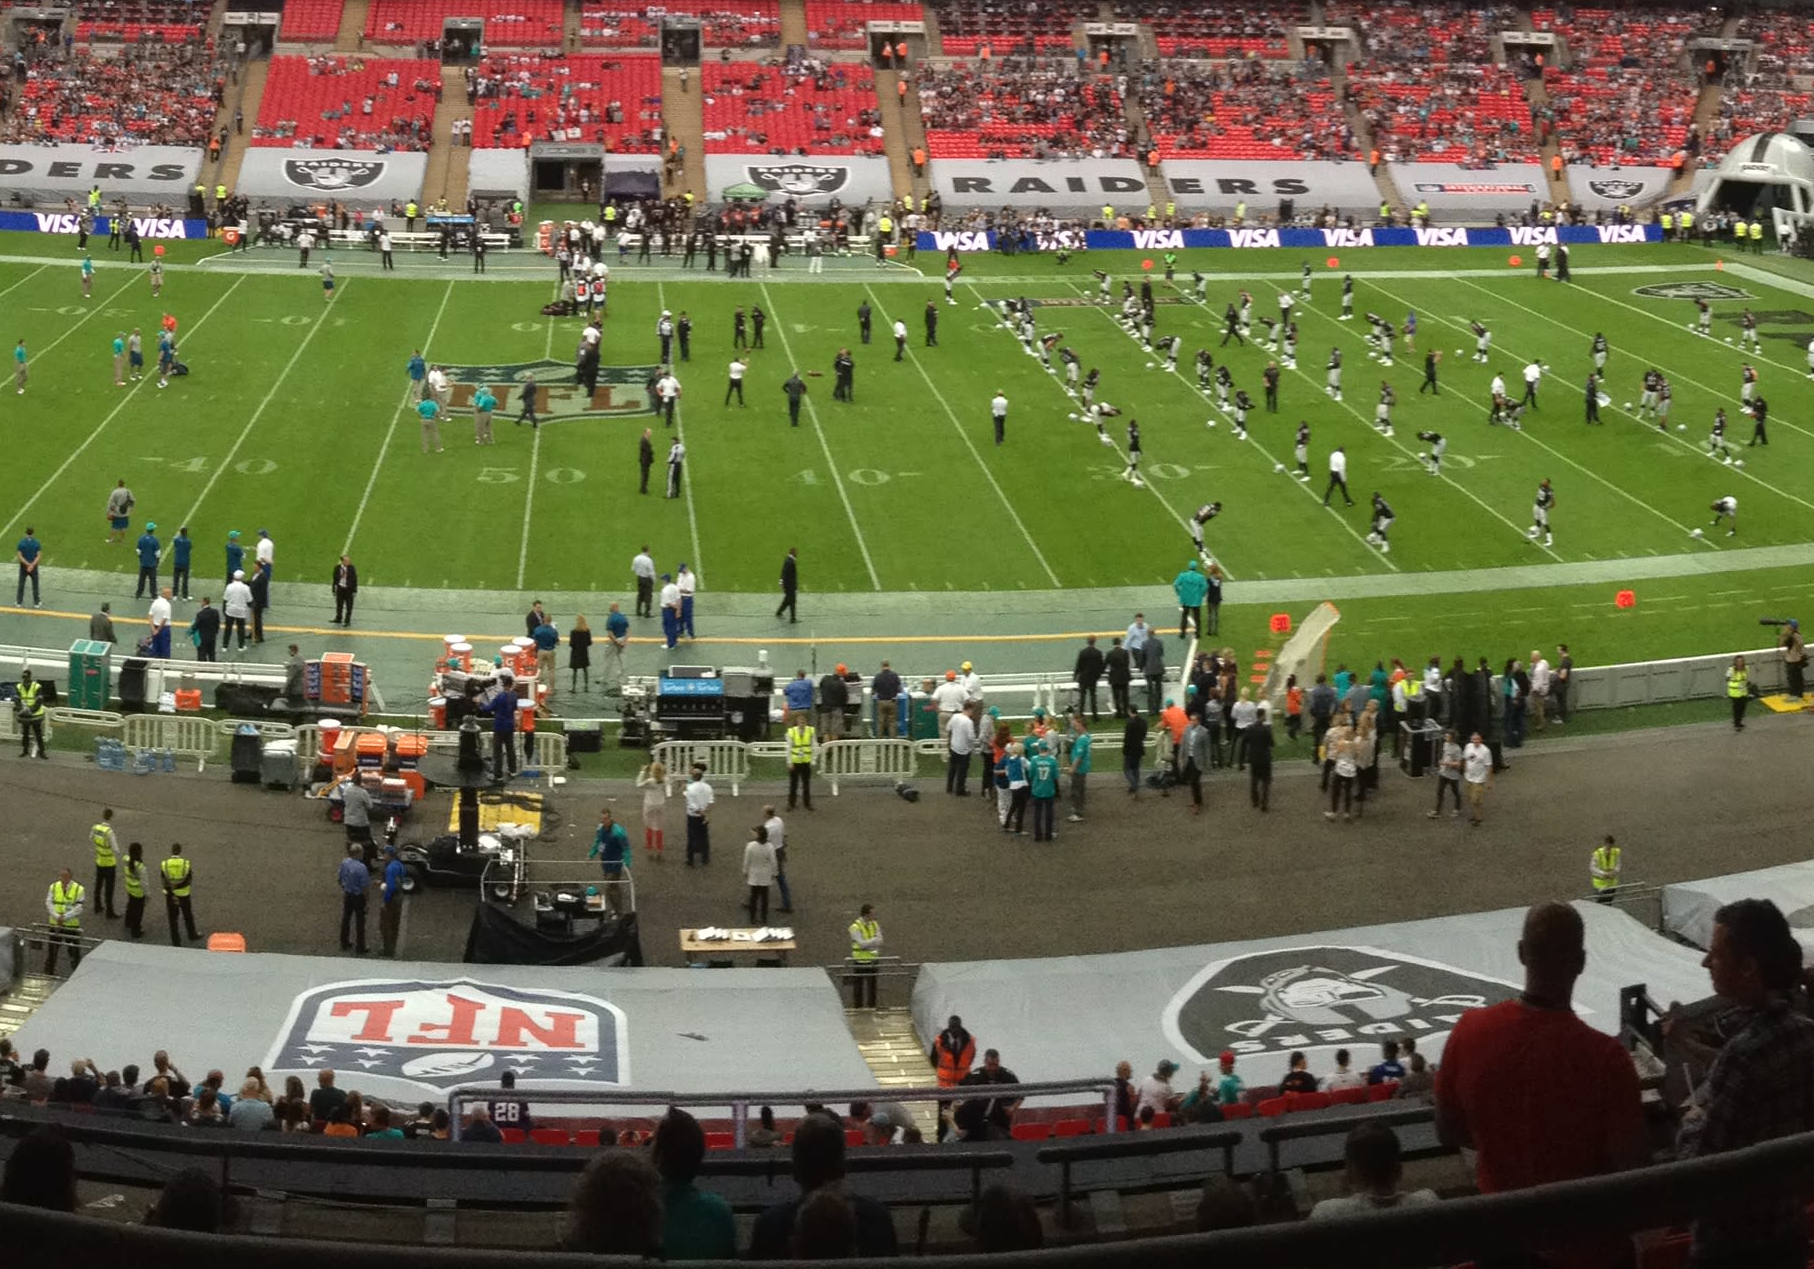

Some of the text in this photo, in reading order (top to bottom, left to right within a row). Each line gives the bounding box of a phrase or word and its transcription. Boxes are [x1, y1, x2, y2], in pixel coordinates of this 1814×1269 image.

[295, 160, 375, 169] RAIDERS
[757, 166, 838, 174] RAIDERS
[952, 176, 1310, 195] RAIDERS
[132, 217, 186, 238] VISA
[226, 231, 235, 242] G
[1413, 228, 1468, 246] VISA
[1507, 226, 1558, 244] VISA
[1596, 224, 1646, 243] VISA
[931, 231, 989, 250] VISA
[1132, 230, 1185, 249] VISA
[1226, 229, 1280, 248] VISA
[1320, 228, 1374, 247] VISA
[170, 457, 278, 475] 40
[477, 467, 587, 484] 50
[1037, 767, 1050, 781] 17
[330, 993, 586, 1049] NFL
[1228, 1013, 1463, 1053] AIDERS
[494, 1101, 520, 1123] 28
